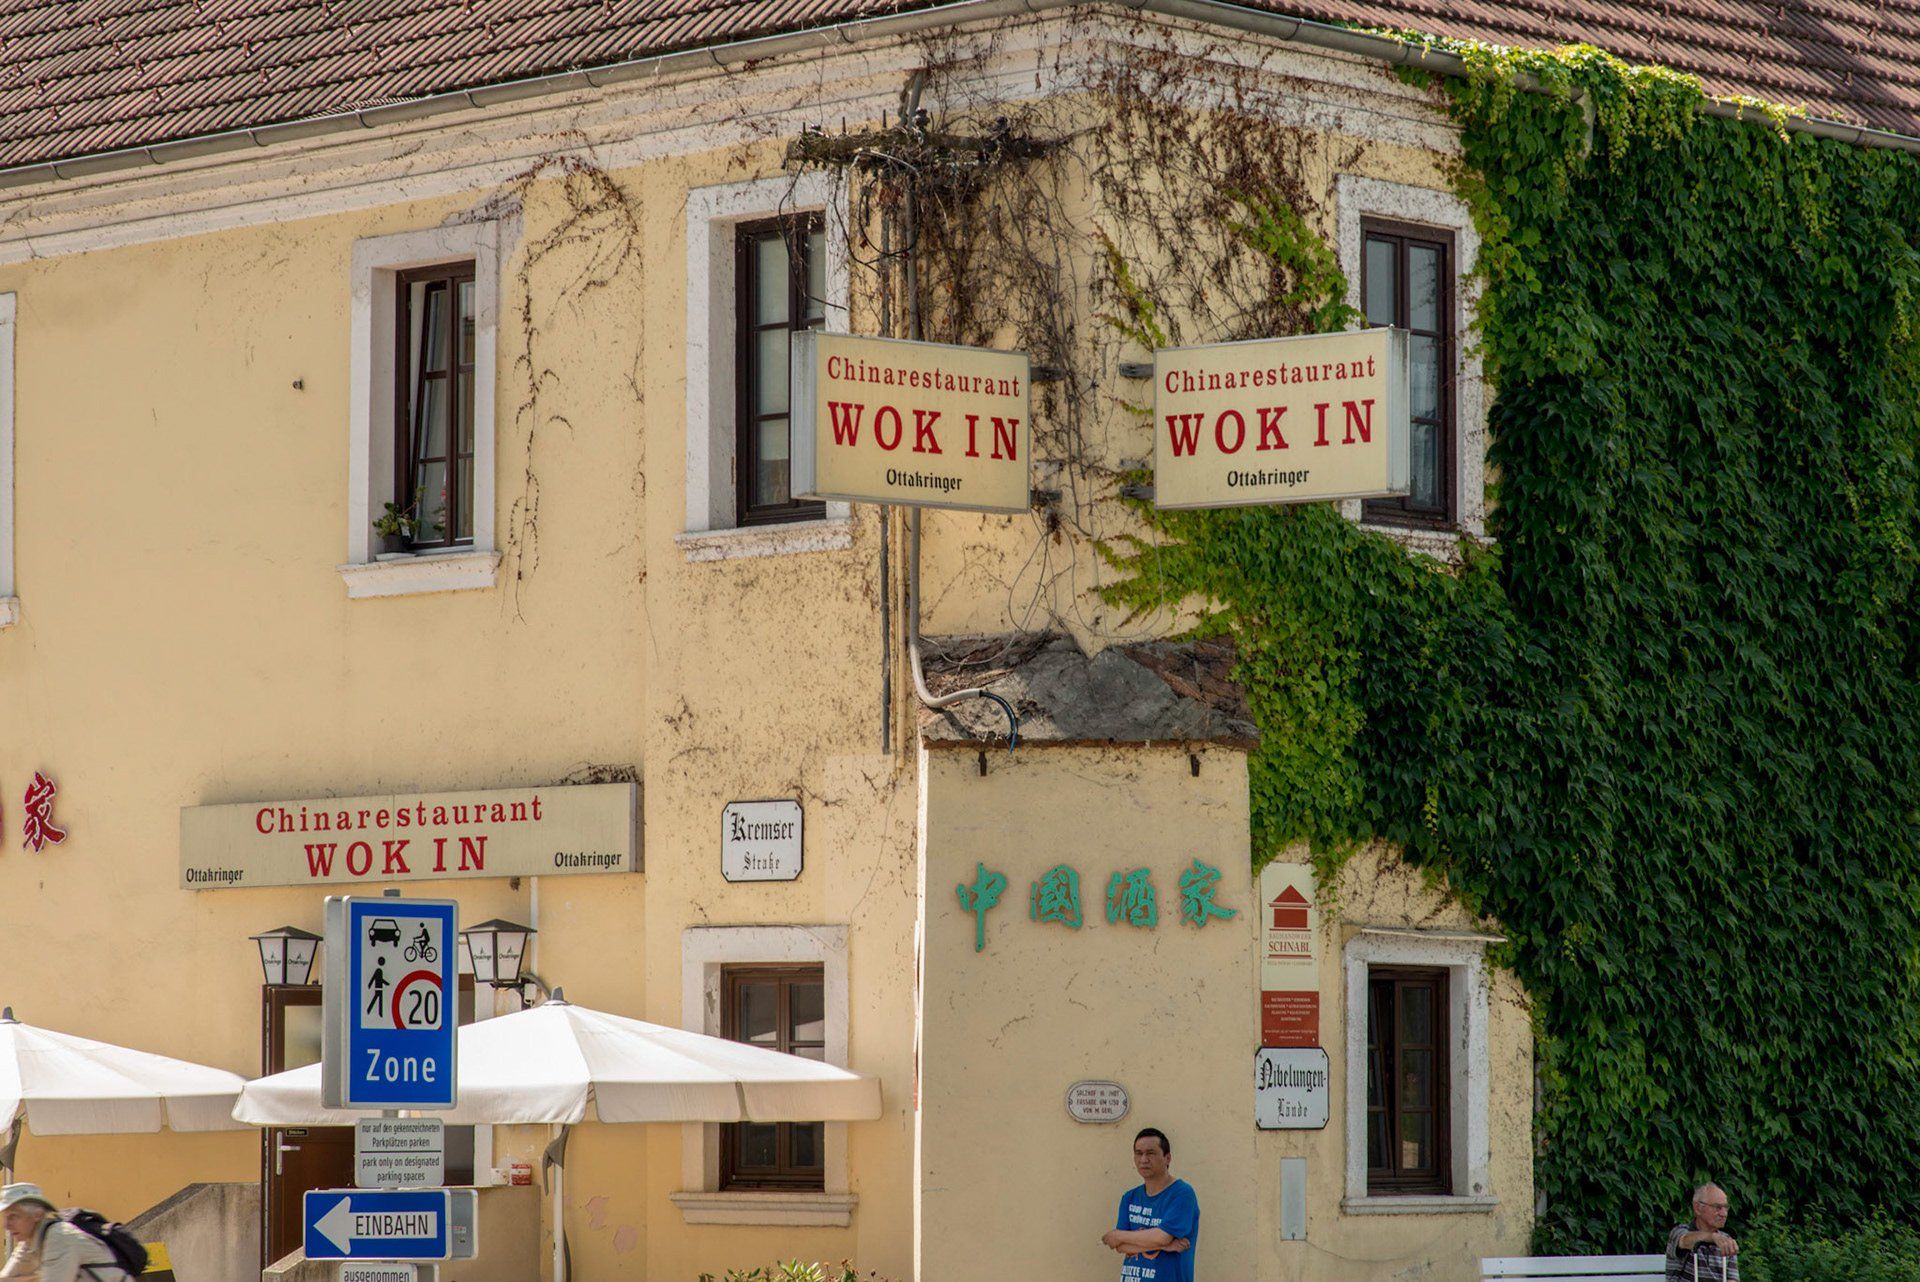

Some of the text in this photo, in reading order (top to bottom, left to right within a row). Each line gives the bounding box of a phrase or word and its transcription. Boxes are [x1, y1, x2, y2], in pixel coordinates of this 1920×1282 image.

[827, 355, 1020, 398] Chinarestaurant
[1165, 354, 1375, 394] Chinarestaurant
[828, 401, 1020, 461] WOK IN
[1165, 399, 1375, 457] WOK IN
[886, 468, 963, 493] Ottakringer
[1227, 468, 1310, 488] Ottakringer
[256, 795, 542, 834] Chinarestaurant
[731, 812, 794, 842] Kremser
[304, 836, 488, 878] WOK IN
[554, 851, 622, 869] Ottakringer
[742, 851, 780, 875] Straße
[186, 867, 244, 884] Ottakringer
[1268, 941, 1311, 952] SCHNABL
[408, 989, 438, 1025] 20
[366, 1048, 436, 1083] Zone
[1258, 1057, 1326, 1092] Nibelungen-
[1277, 1098, 1308, 1124] Lände
[383, 1123, 392, 1132] den
[372, 1137, 430, 1149] Parkplätzen parken
[362, 1157, 377, 1168] park
[378, 1157, 393, 1168] only
[404, 1156, 440, 1168] designated
[377, 1171, 426, 1183] parking spaces
[355, 1214, 428, 1236] EINBAHN
[344, 1270, 409, 1282] ausgenommen
